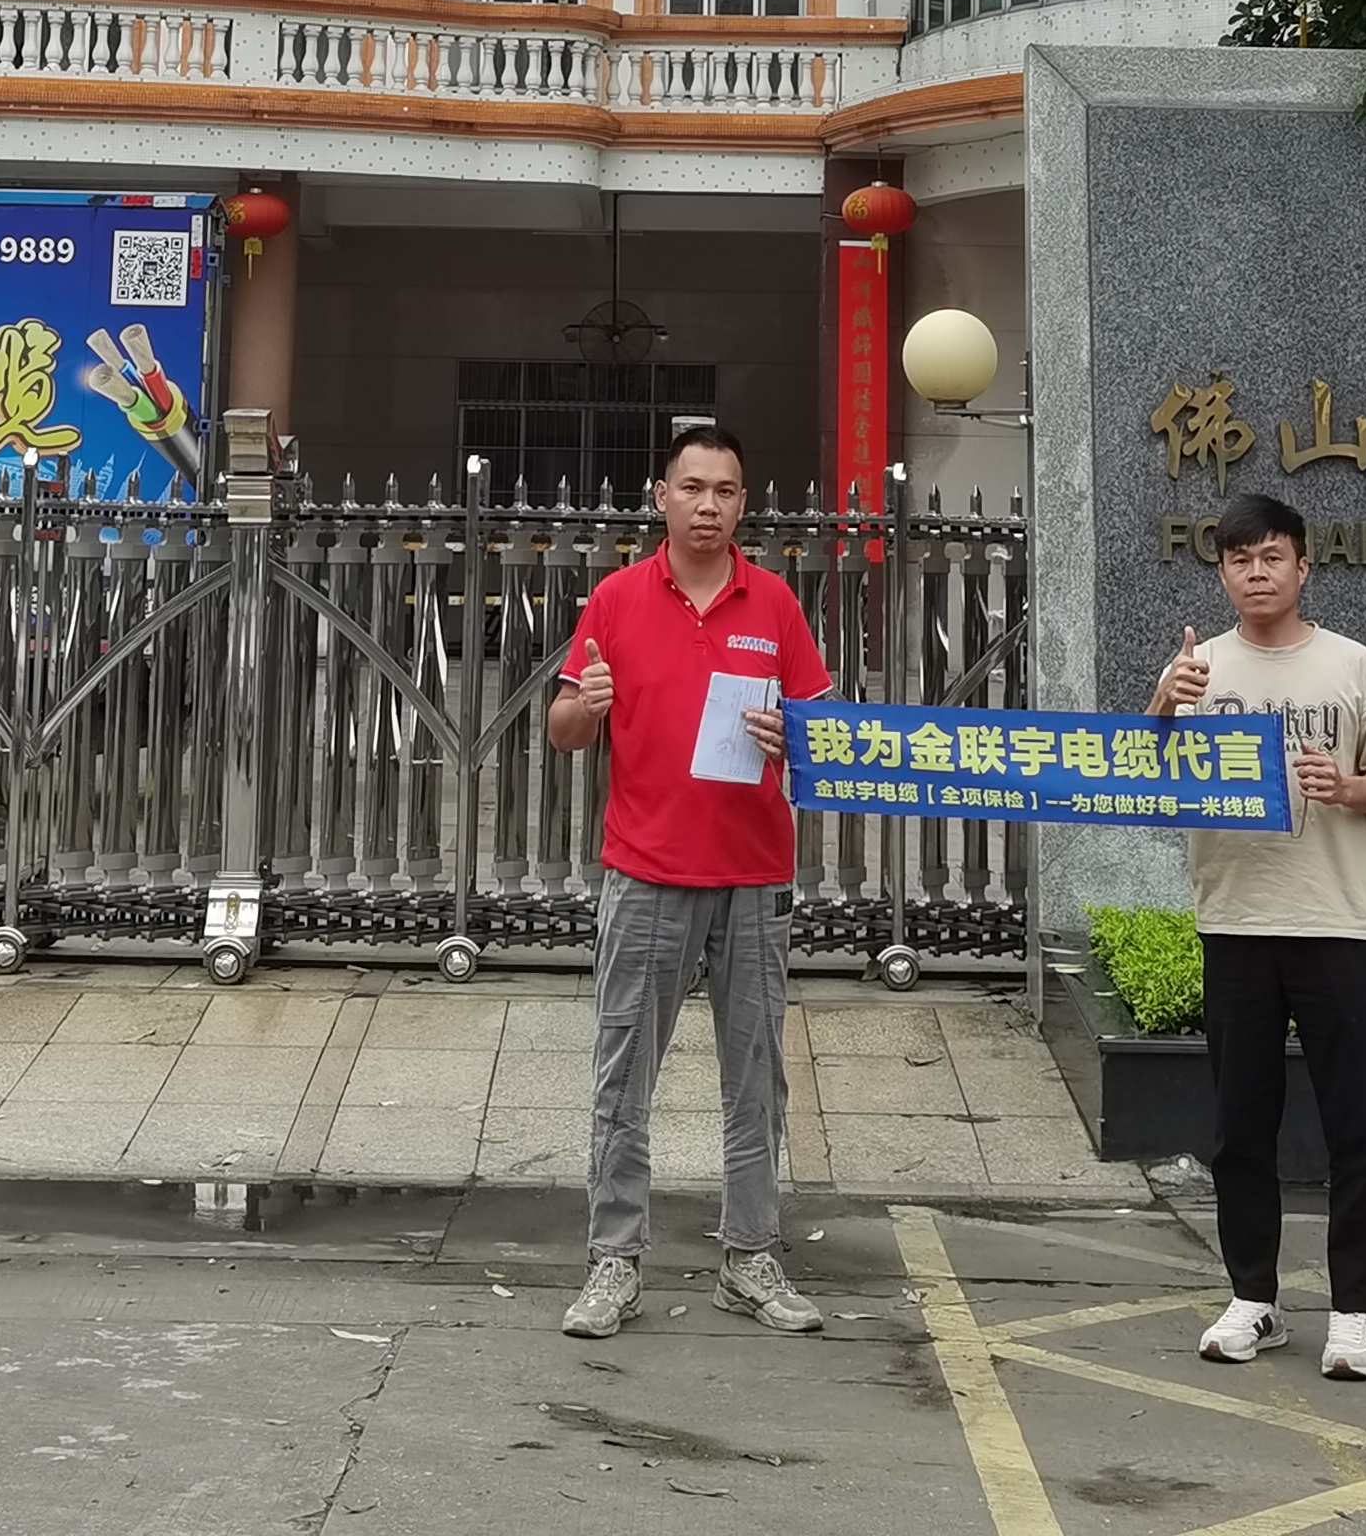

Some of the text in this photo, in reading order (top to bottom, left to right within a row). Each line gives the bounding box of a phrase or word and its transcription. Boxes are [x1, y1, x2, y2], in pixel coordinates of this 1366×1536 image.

[806, 716, 1263, 782] 我为金联宇电缆代言
